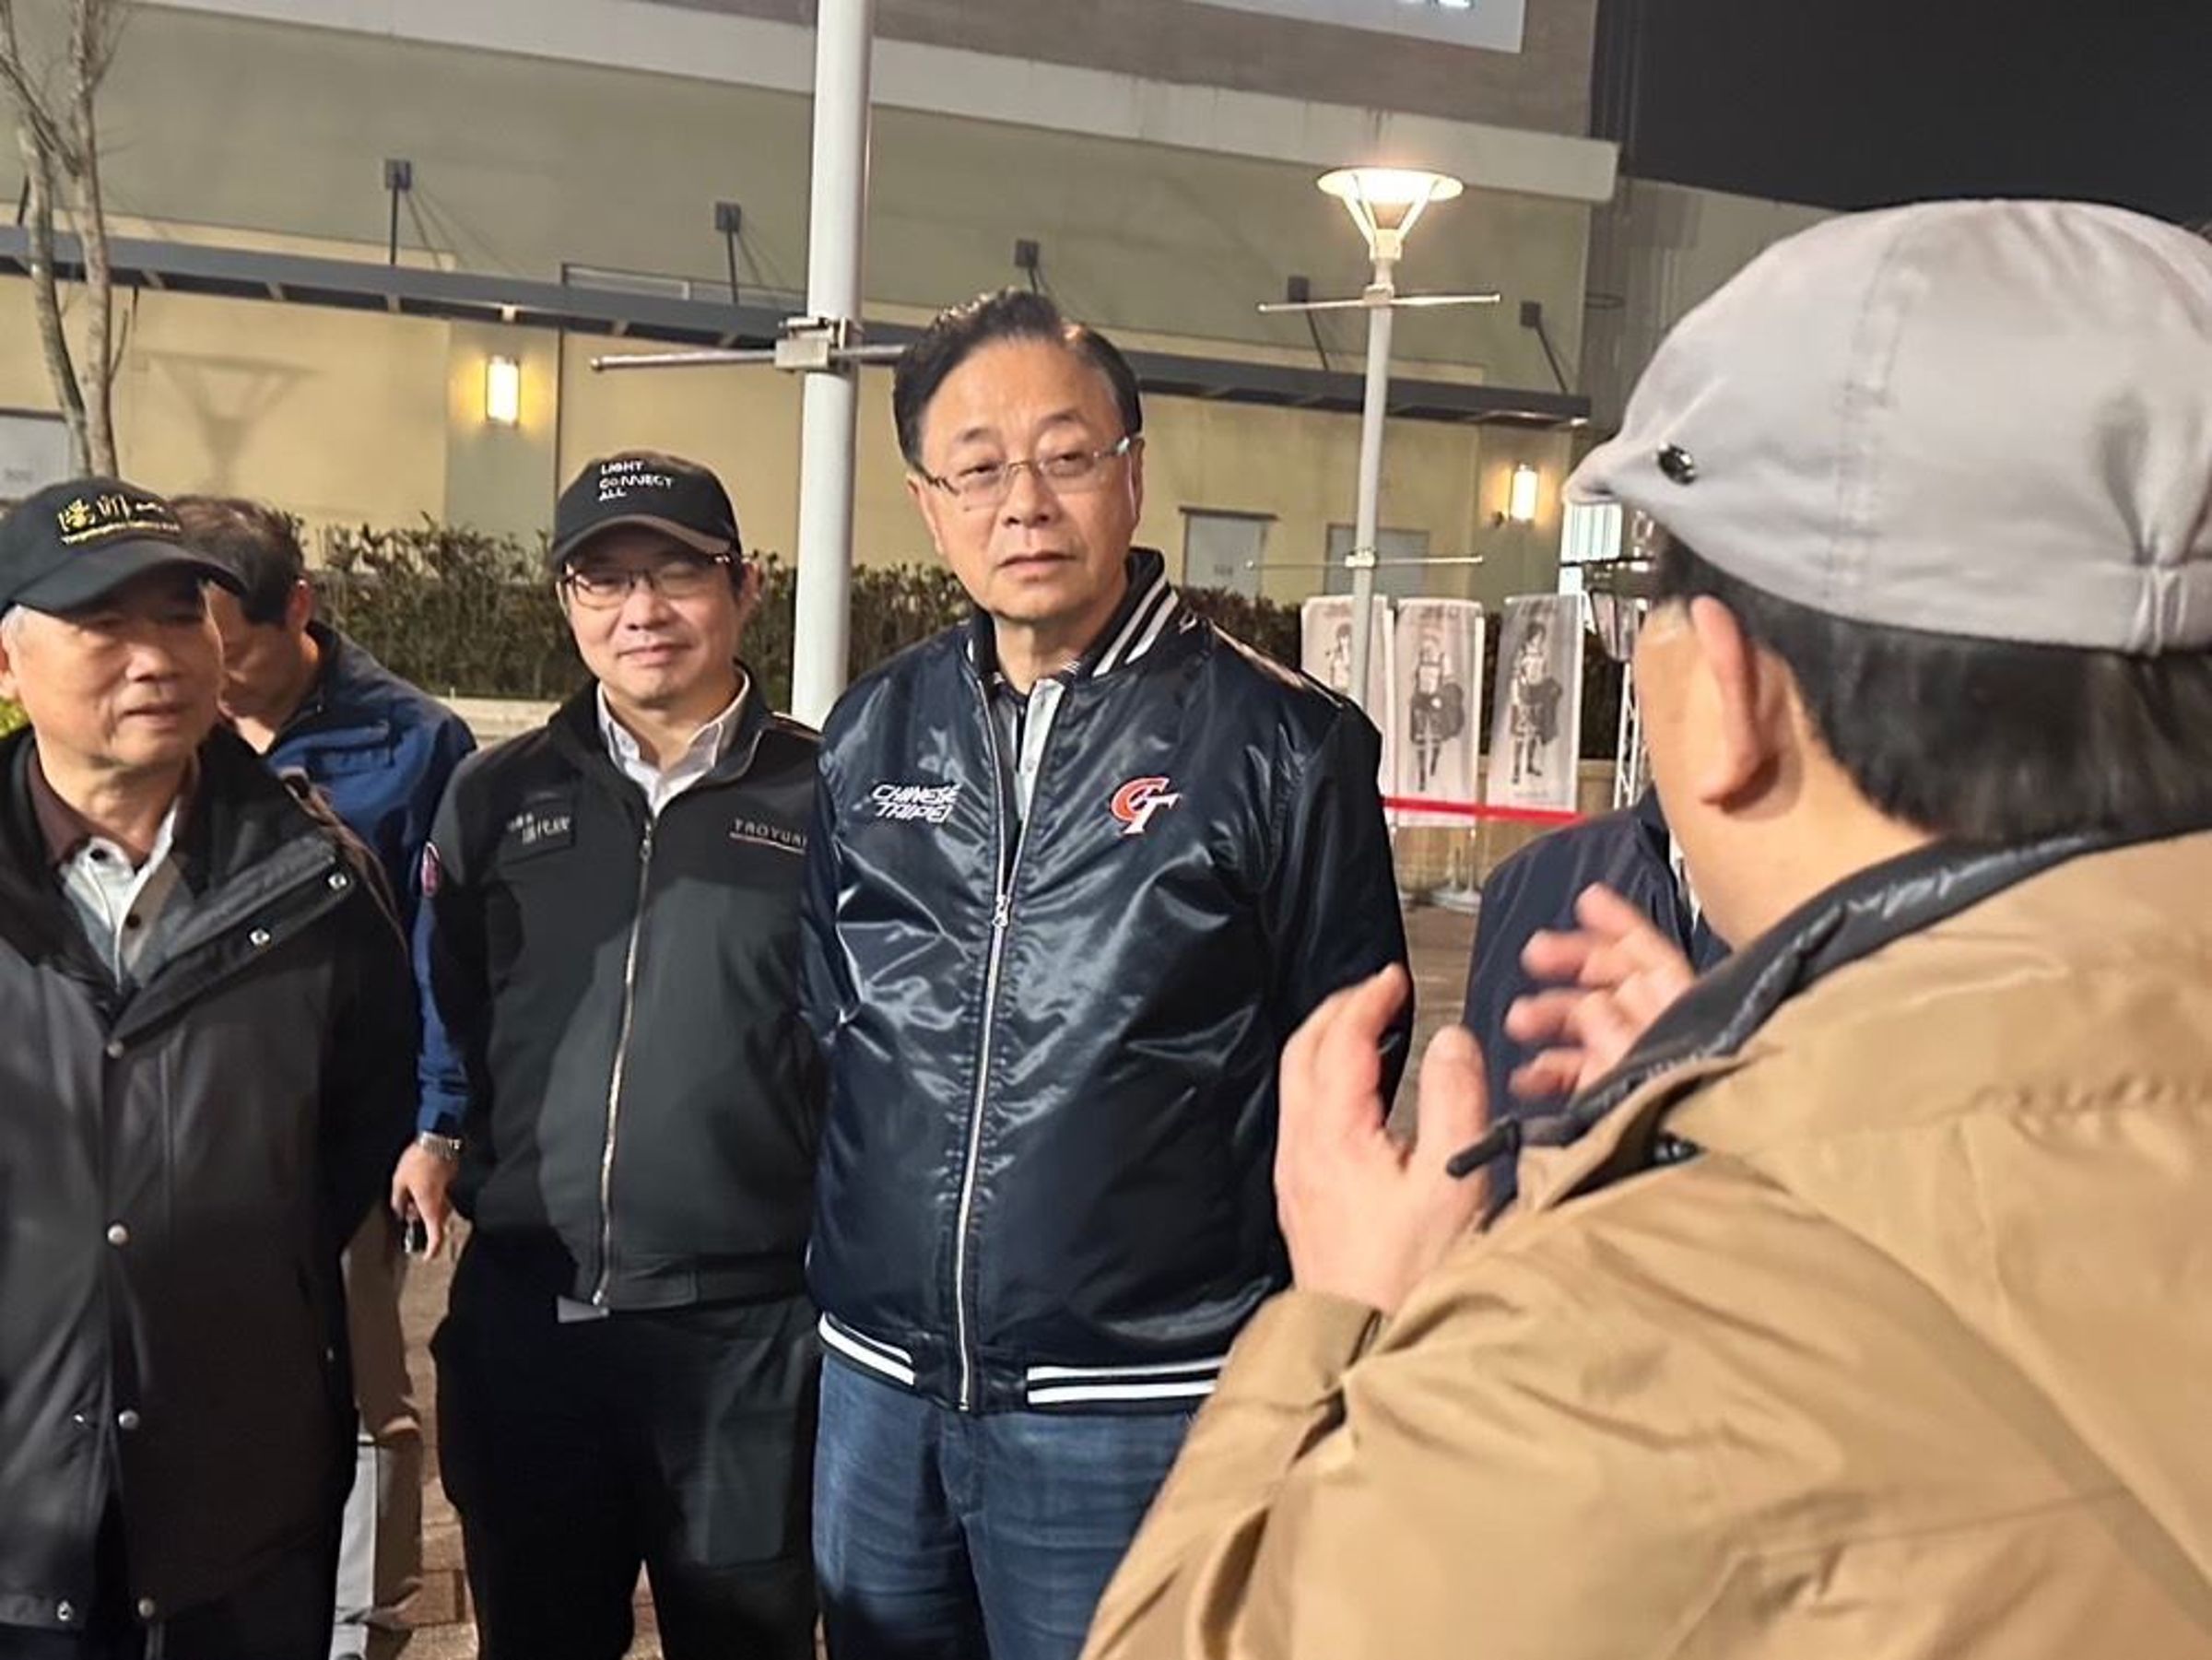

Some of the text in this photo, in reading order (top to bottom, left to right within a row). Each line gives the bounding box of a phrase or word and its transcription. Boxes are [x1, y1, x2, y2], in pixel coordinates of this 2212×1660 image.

[601, 461, 643, 475] LIGHT
[599, 474, 672, 489] CONNECT
[599, 488, 627, 501] ALL
[872, 783, 961, 804] CHINESE
[875, 801, 953, 823] TAIPEI
